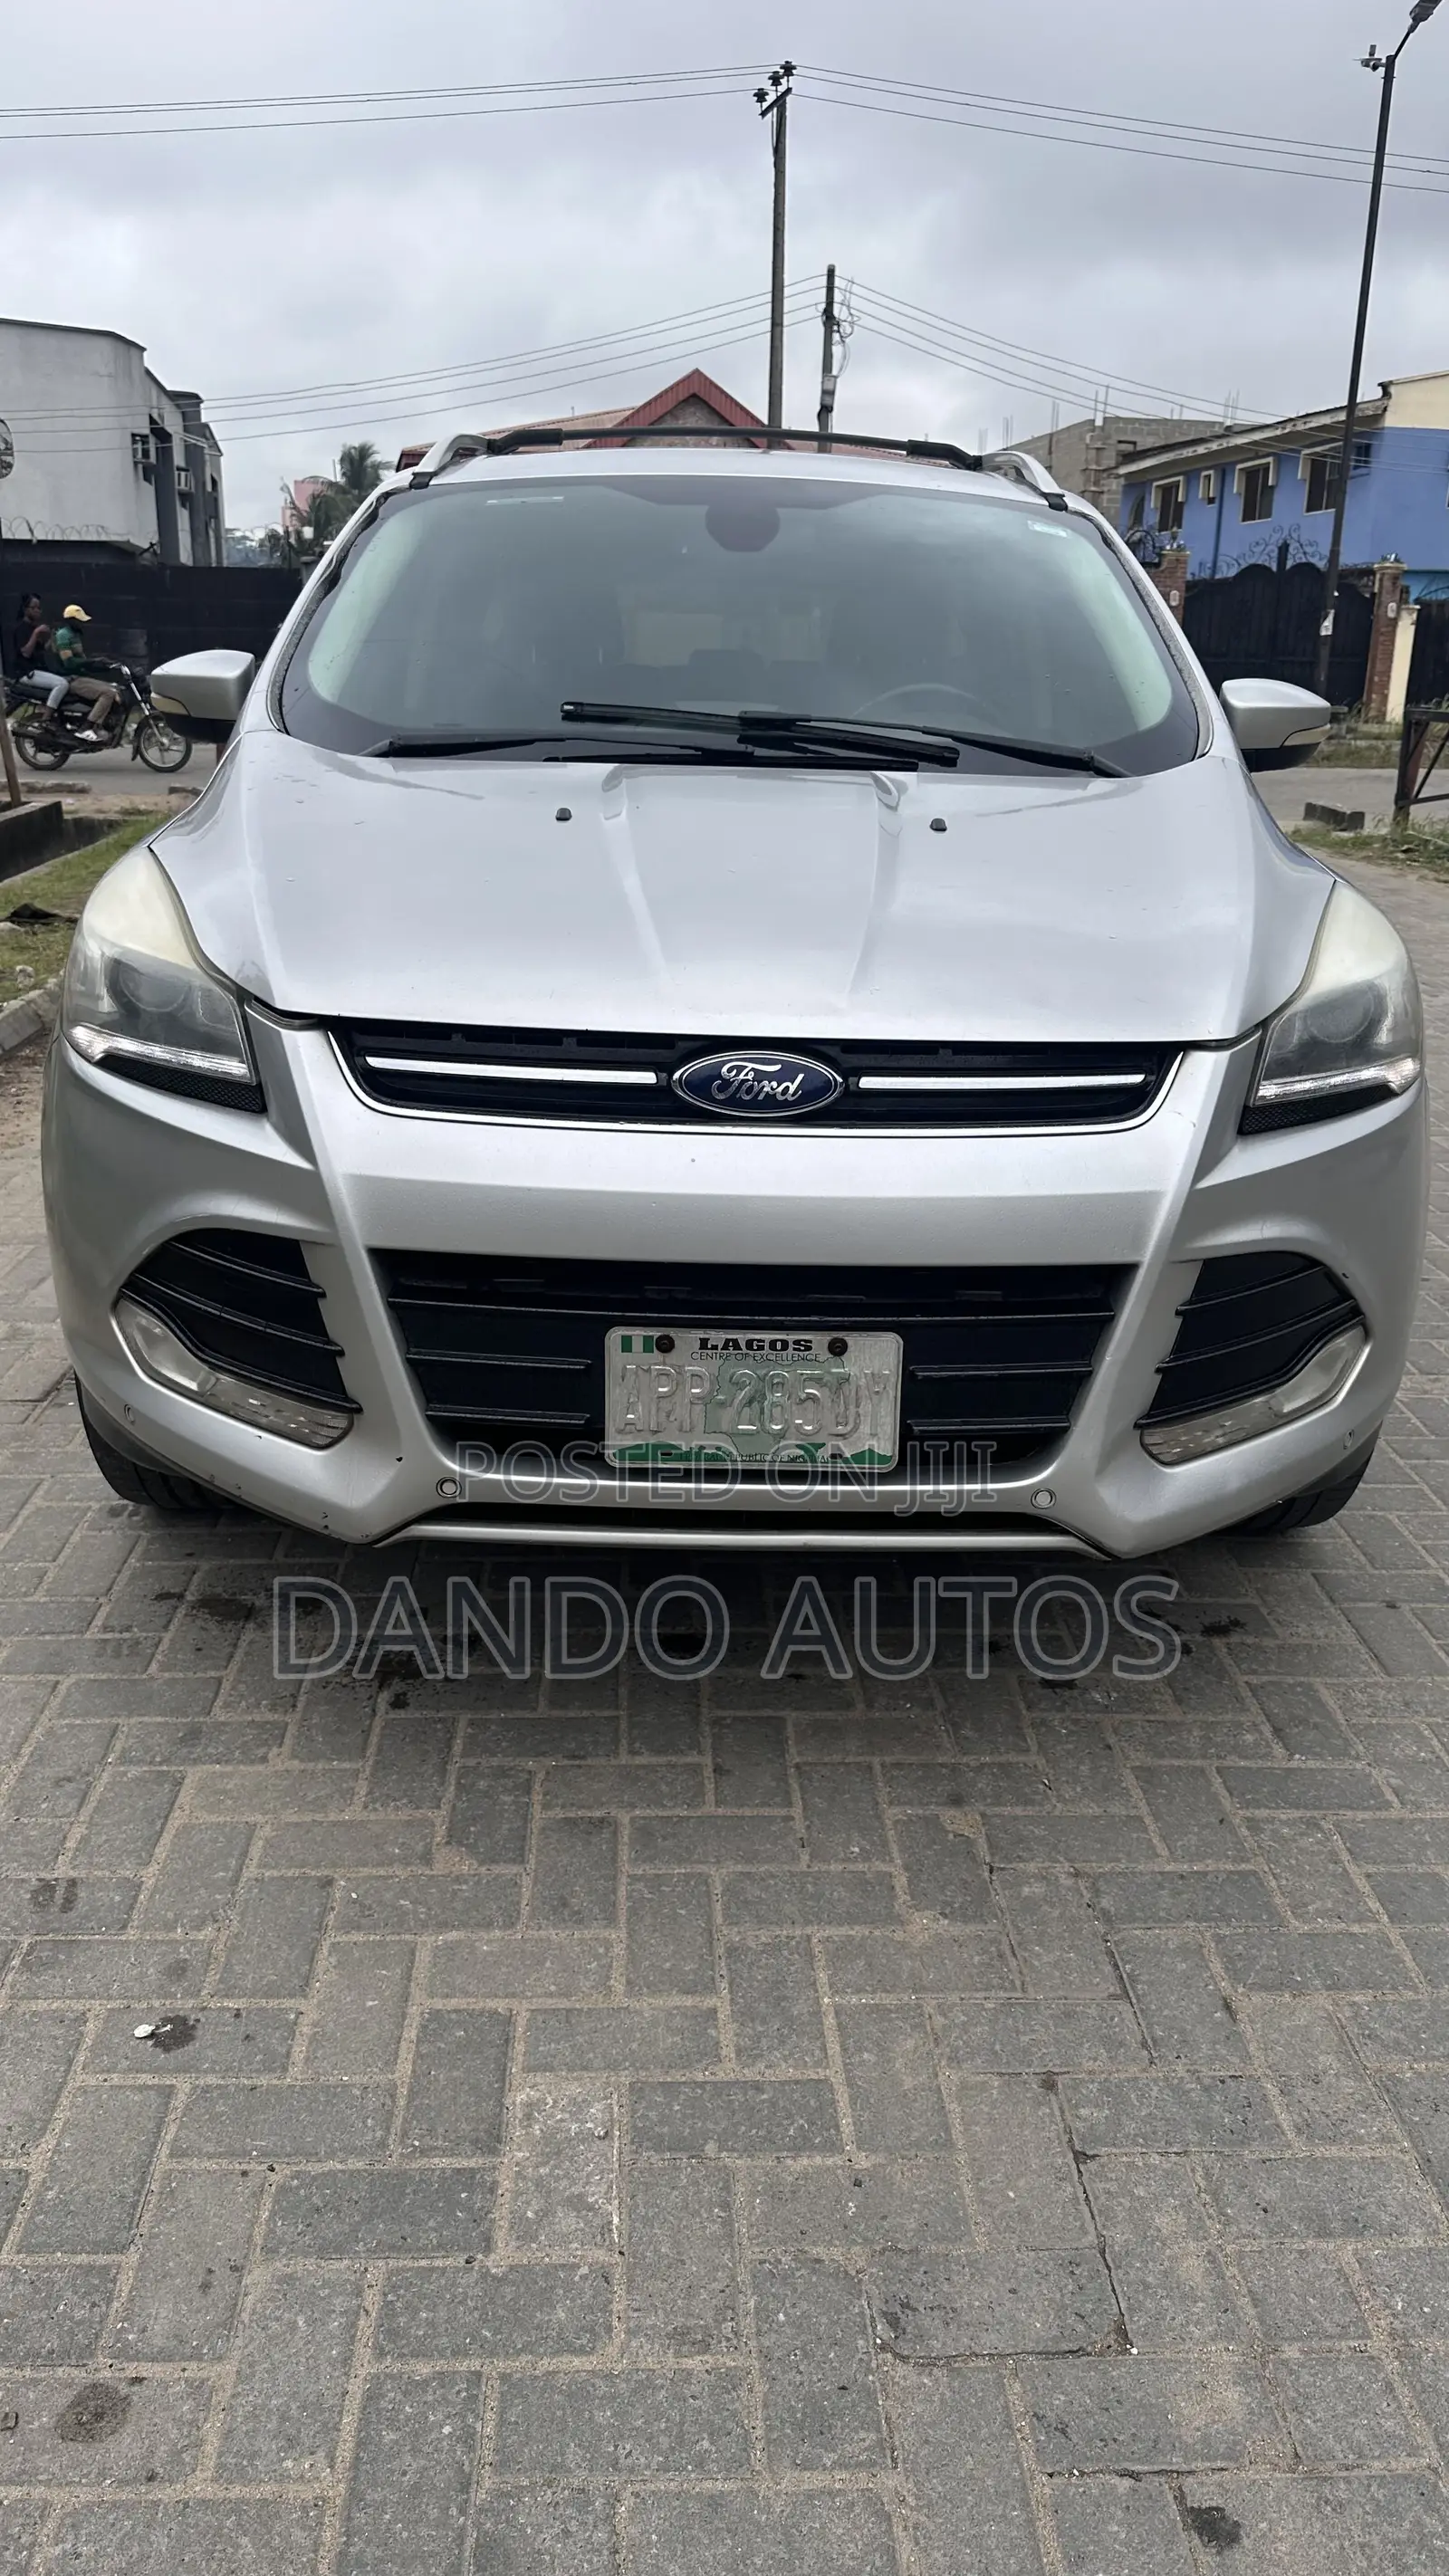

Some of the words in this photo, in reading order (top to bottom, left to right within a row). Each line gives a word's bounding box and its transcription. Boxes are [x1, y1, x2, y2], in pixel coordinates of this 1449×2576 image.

[710, 1061, 805, 1102] Ford
[698, 1337, 814, 1353] LAGOS
[690, 1351, 731, 1361] CENTRE
[734, 1352, 752, 1362] OF
[753, 1352, 821, 1363] EXCELLENCE
